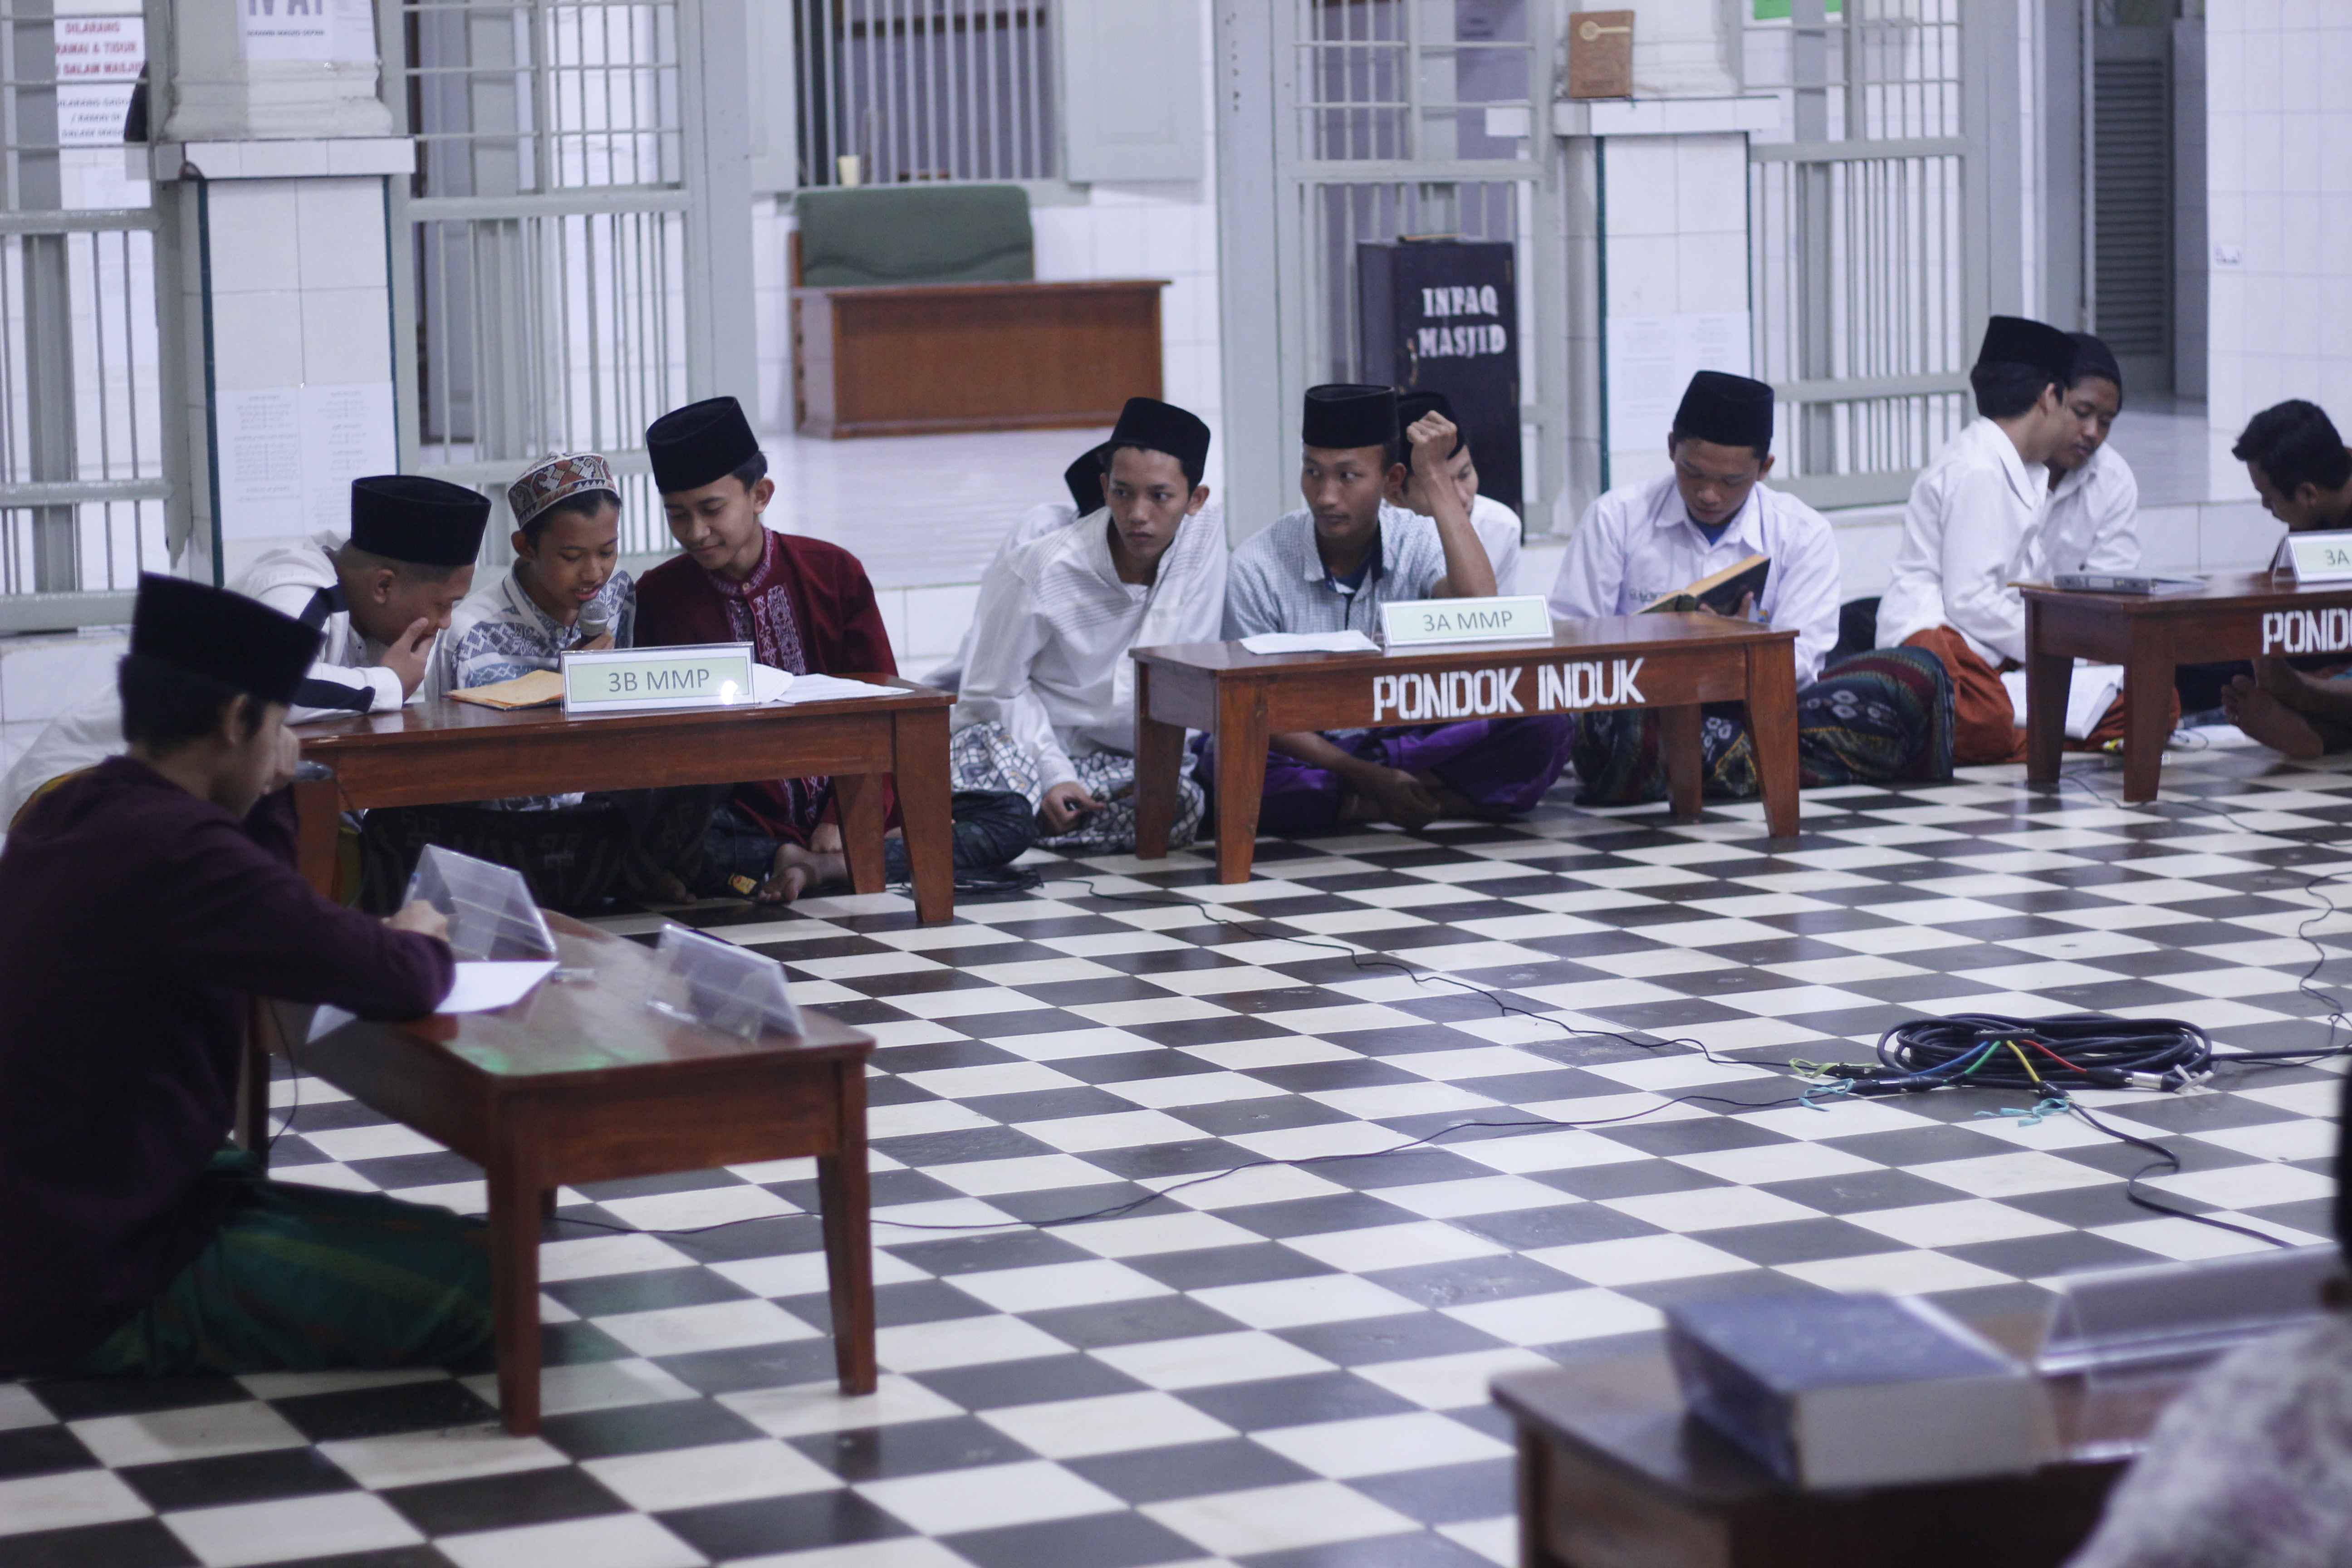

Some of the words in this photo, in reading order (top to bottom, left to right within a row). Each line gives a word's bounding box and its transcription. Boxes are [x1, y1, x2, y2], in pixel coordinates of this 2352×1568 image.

[1417, 324, 1507, 358] MASJID
[2325, 548, 2351, 565] 3A
[1423, 613, 1451, 632] 3A
[1457, 610, 1513, 630] MMP
[2263, 608, 2352, 654] POND
[608, 672, 638, 692] 3B
[647, 668, 710, 690] MMP
[1373, 667, 1524, 722] PONDOK
[1537, 658, 1646, 711] INDUK
